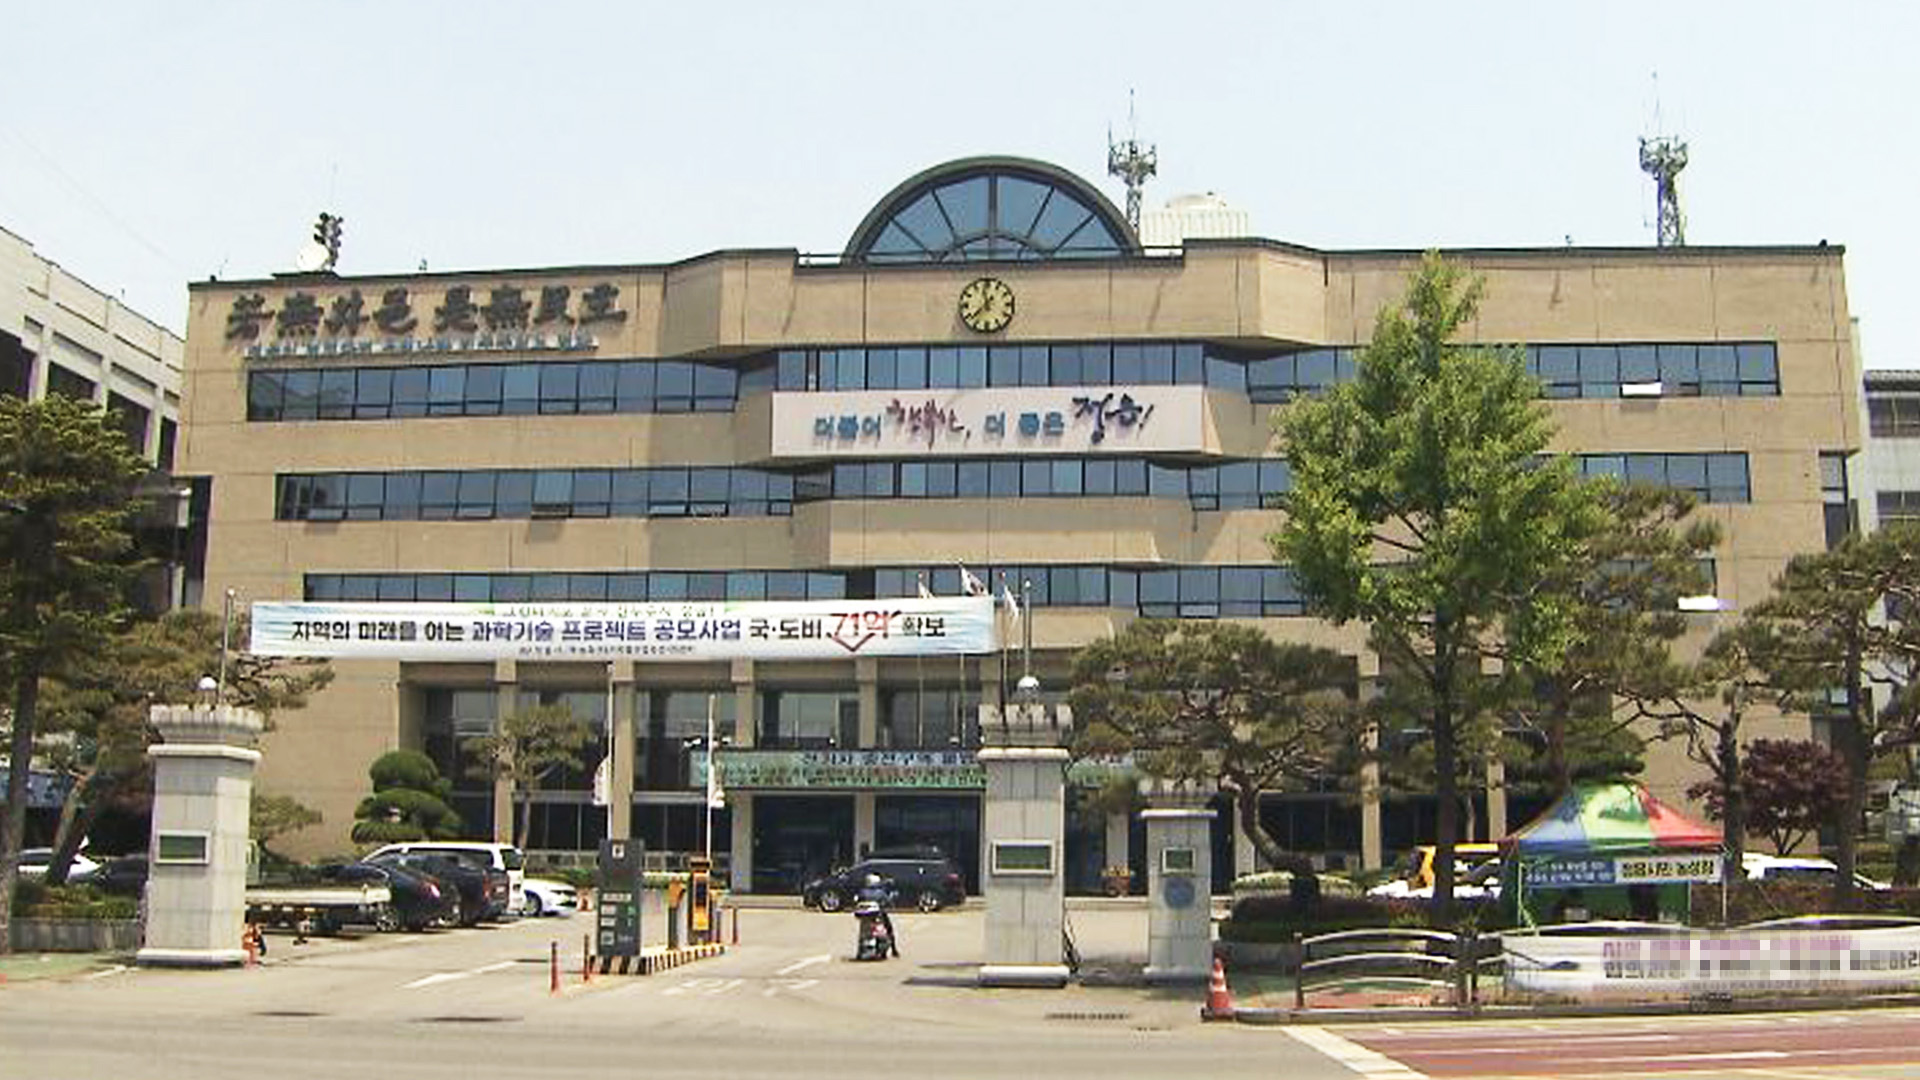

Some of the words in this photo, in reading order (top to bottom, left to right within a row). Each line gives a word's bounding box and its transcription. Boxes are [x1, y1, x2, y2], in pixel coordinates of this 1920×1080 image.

[814, 411, 881, 441] 더불어
[984, 411, 1004, 439] 더
[291, 620, 350, 641] 지역의
[358, 620, 417, 641] 미래를
[472, 620, 554, 642] 과학기술
[562, 620, 646, 641] 프로젝트
[653, 618, 741, 641] 공모사업
[902, 616, 945, 638] 확보
